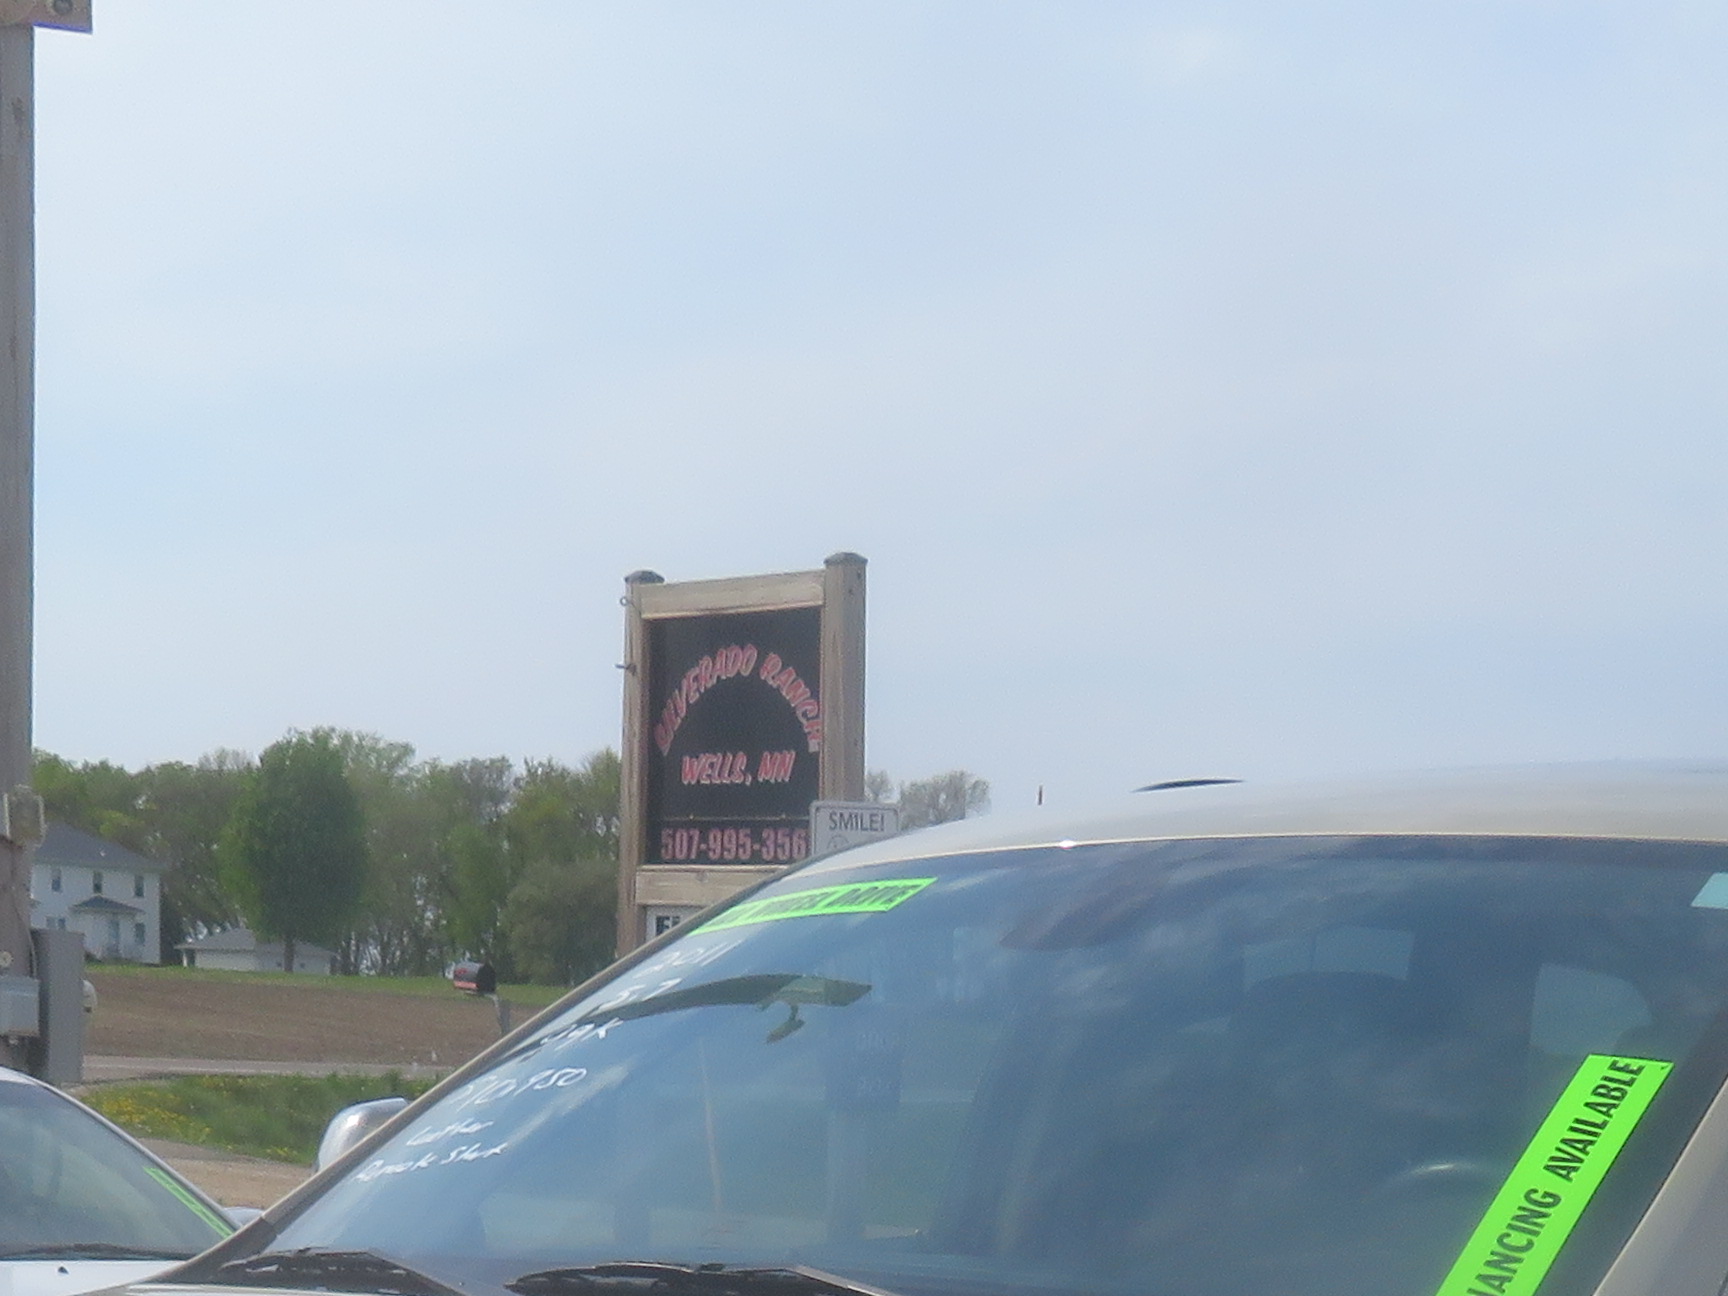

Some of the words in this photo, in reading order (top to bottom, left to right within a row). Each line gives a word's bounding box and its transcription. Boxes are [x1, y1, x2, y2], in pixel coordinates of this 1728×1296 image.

[654, 644, 758, 756] SILVERADO
[759, 652, 822, 753] RANCH
[681, 751, 752, 786] WELLS,
[757, 750, 796, 783] MN
[829, 811, 885, 832] SMILE!
[661, 828, 809, 860] 507-995-356
[1543, 1059, 1646, 1183] AVAILABLE
